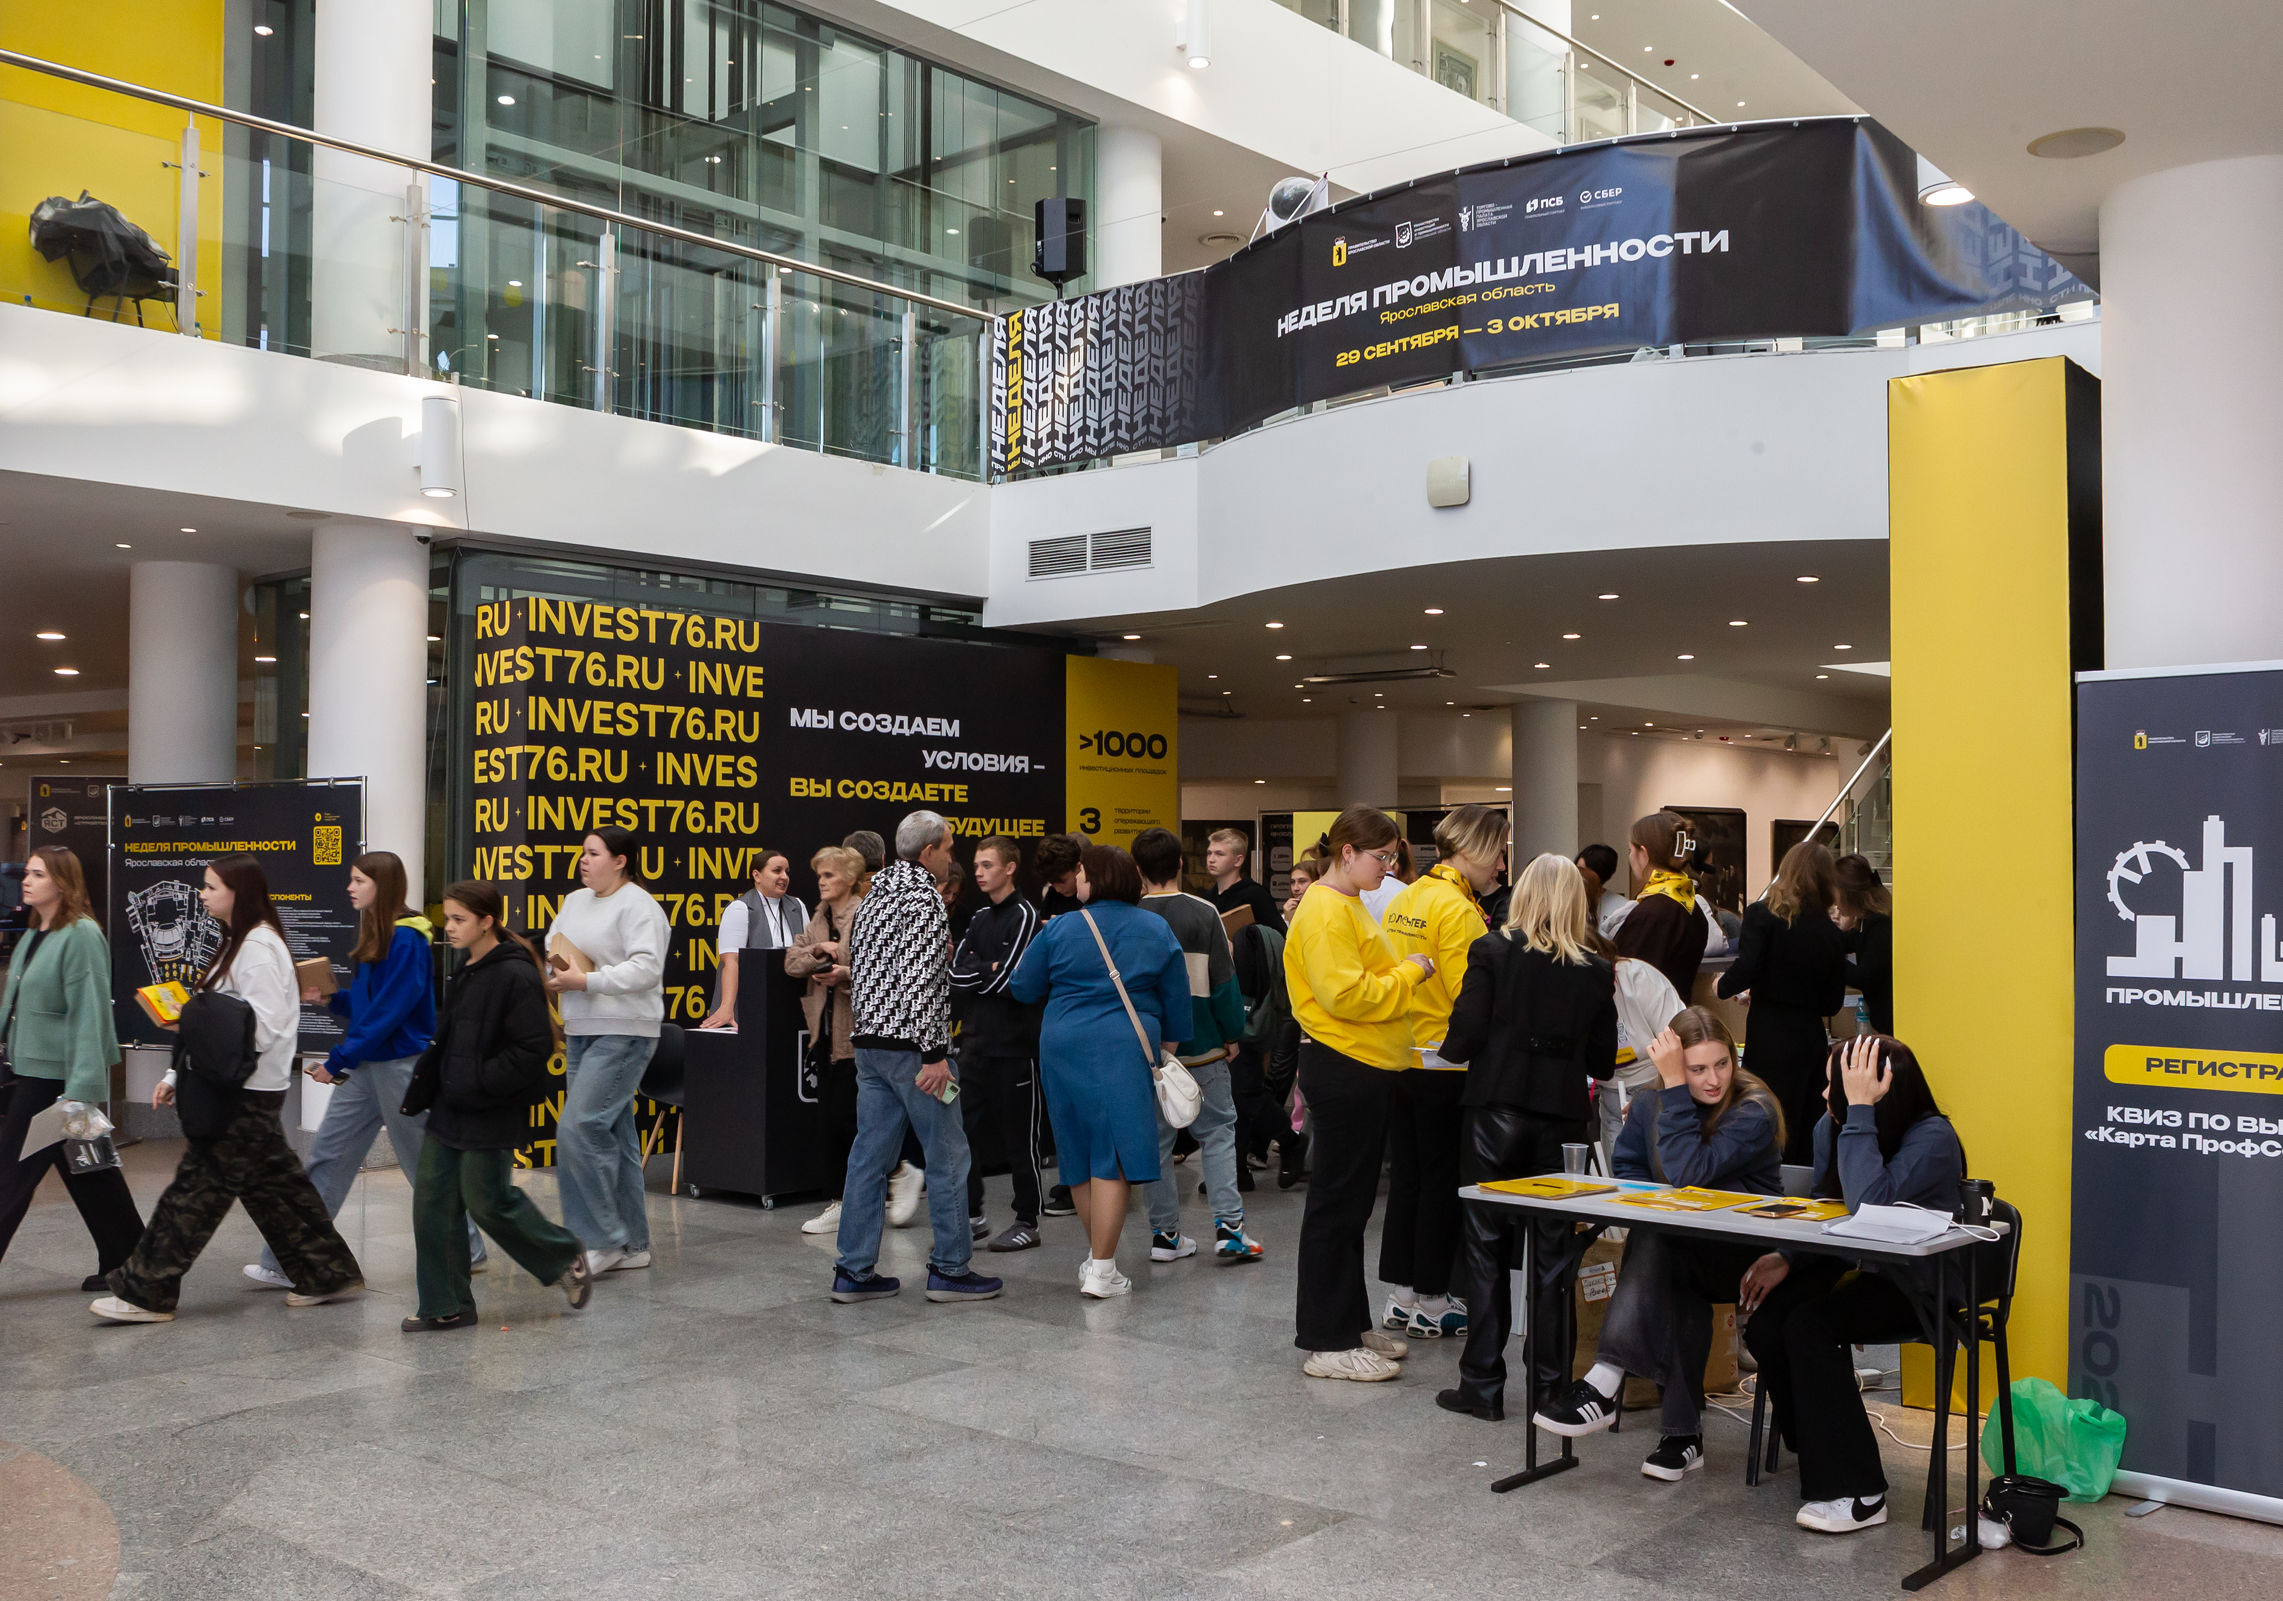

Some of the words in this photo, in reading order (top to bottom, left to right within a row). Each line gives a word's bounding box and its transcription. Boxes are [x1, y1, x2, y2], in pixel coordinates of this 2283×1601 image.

[1540, 196, 1563, 209] ПСБ
[1594, 187, 1622, 199] СБЕР
[1277, 292, 1369, 338] НЕДЕЛЯ
[1373, 229, 1730, 305] ПРОМЫШЛЕННОСТИ
[1379, 292, 1477, 326] Ярославская
[1481, 280, 1556, 302] область
[1335, 352, 1361, 368] 29
[1363, 325, 1459, 361] СЕНТЯБРЯ
[1487, 317, 1504, 335] 3
[1508, 303, 1620, 331] ОКТЯБРЯ
[1038, 302, 1054, 456] НЕДЕЛЯ
[1055, 301, 1069, 452] НЕДЕЛЯ
[1069, 296, 1085, 451] НЕДЕЛЯ
[1086, 294, 1100, 447] НЕДЕЛЯ
[1101, 288, 1117, 446] НЕДЕЛЯ
[1118, 286, 1132, 442] НЕДЕЛЯ
[1133, 281, 1150, 441] НЕДЕЛЯ
[1150, 281, 1165, 436] НЕДЕЛЯ
[992, 316, 1007, 462] НЕДЕЛЯ
[1008, 309, 1023, 461] НЕДЕЛЯ
[1023, 307, 1037, 457] НЕДЕЛЯ
[992, 461, 1005, 472] ПРО
[1008, 457, 1021, 471] МЫ
[1022, 456, 1035, 468] ШЛЕ
[1038, 451, 1053, 465] ННО
[1054, 450, 1067, 461] СТИ
[1069, 447, 1083, 460] ПРО
[1085, 445, 1097, 456] МЫ
[528, 596, 760, 653] INVEST76.RU
[689, 660, 764, 698] INVE
[476, 698, 509, 736] RU
[528, 696, 760, 743] INVEST76.RU
[790, 707, 834, 730] МЫ
[839, 710, 960, 738] СОЗДАЕМ
[922, 750, 1029, 774] УСЛОВИЯ
[1080, 729, 1167, 759] >1000
[474, 745, 628, 784] EST76.RU
[657, 752, 758, 788] INVES
[790, 777, 832, 798] ВЫ
[837, 779, 969, 803] СОЗДАЕТЕ
[475, 797, 509, 832] RU
[527, 795, 760, 834] INVEST76.RU
[943, 816, 1045, 839] БУДУЩЕЕ
[1080, 807, 1101, 835] 3
[125, 842, 171, 853] НЕДЕЛЯ
[173, 840, 296, 853] ПРОМЫШЛЕННОСТИ
[125, 858, 183, 869] Ярославская
[185, 857, 214, 868] облас
[268, 893, 312, 901] СПОНЕНТЫ
[2106, 987, 2283, 1011] ПРОМЫШЛЕ
[2107, 1106, 2182, 1127] КВИЗ
[2188, 1112, 2231, 1129] ПО
[2085, 1126, 2177, 1149] «Карта
[2182, 1133, 2283, 1158] ПрофС
